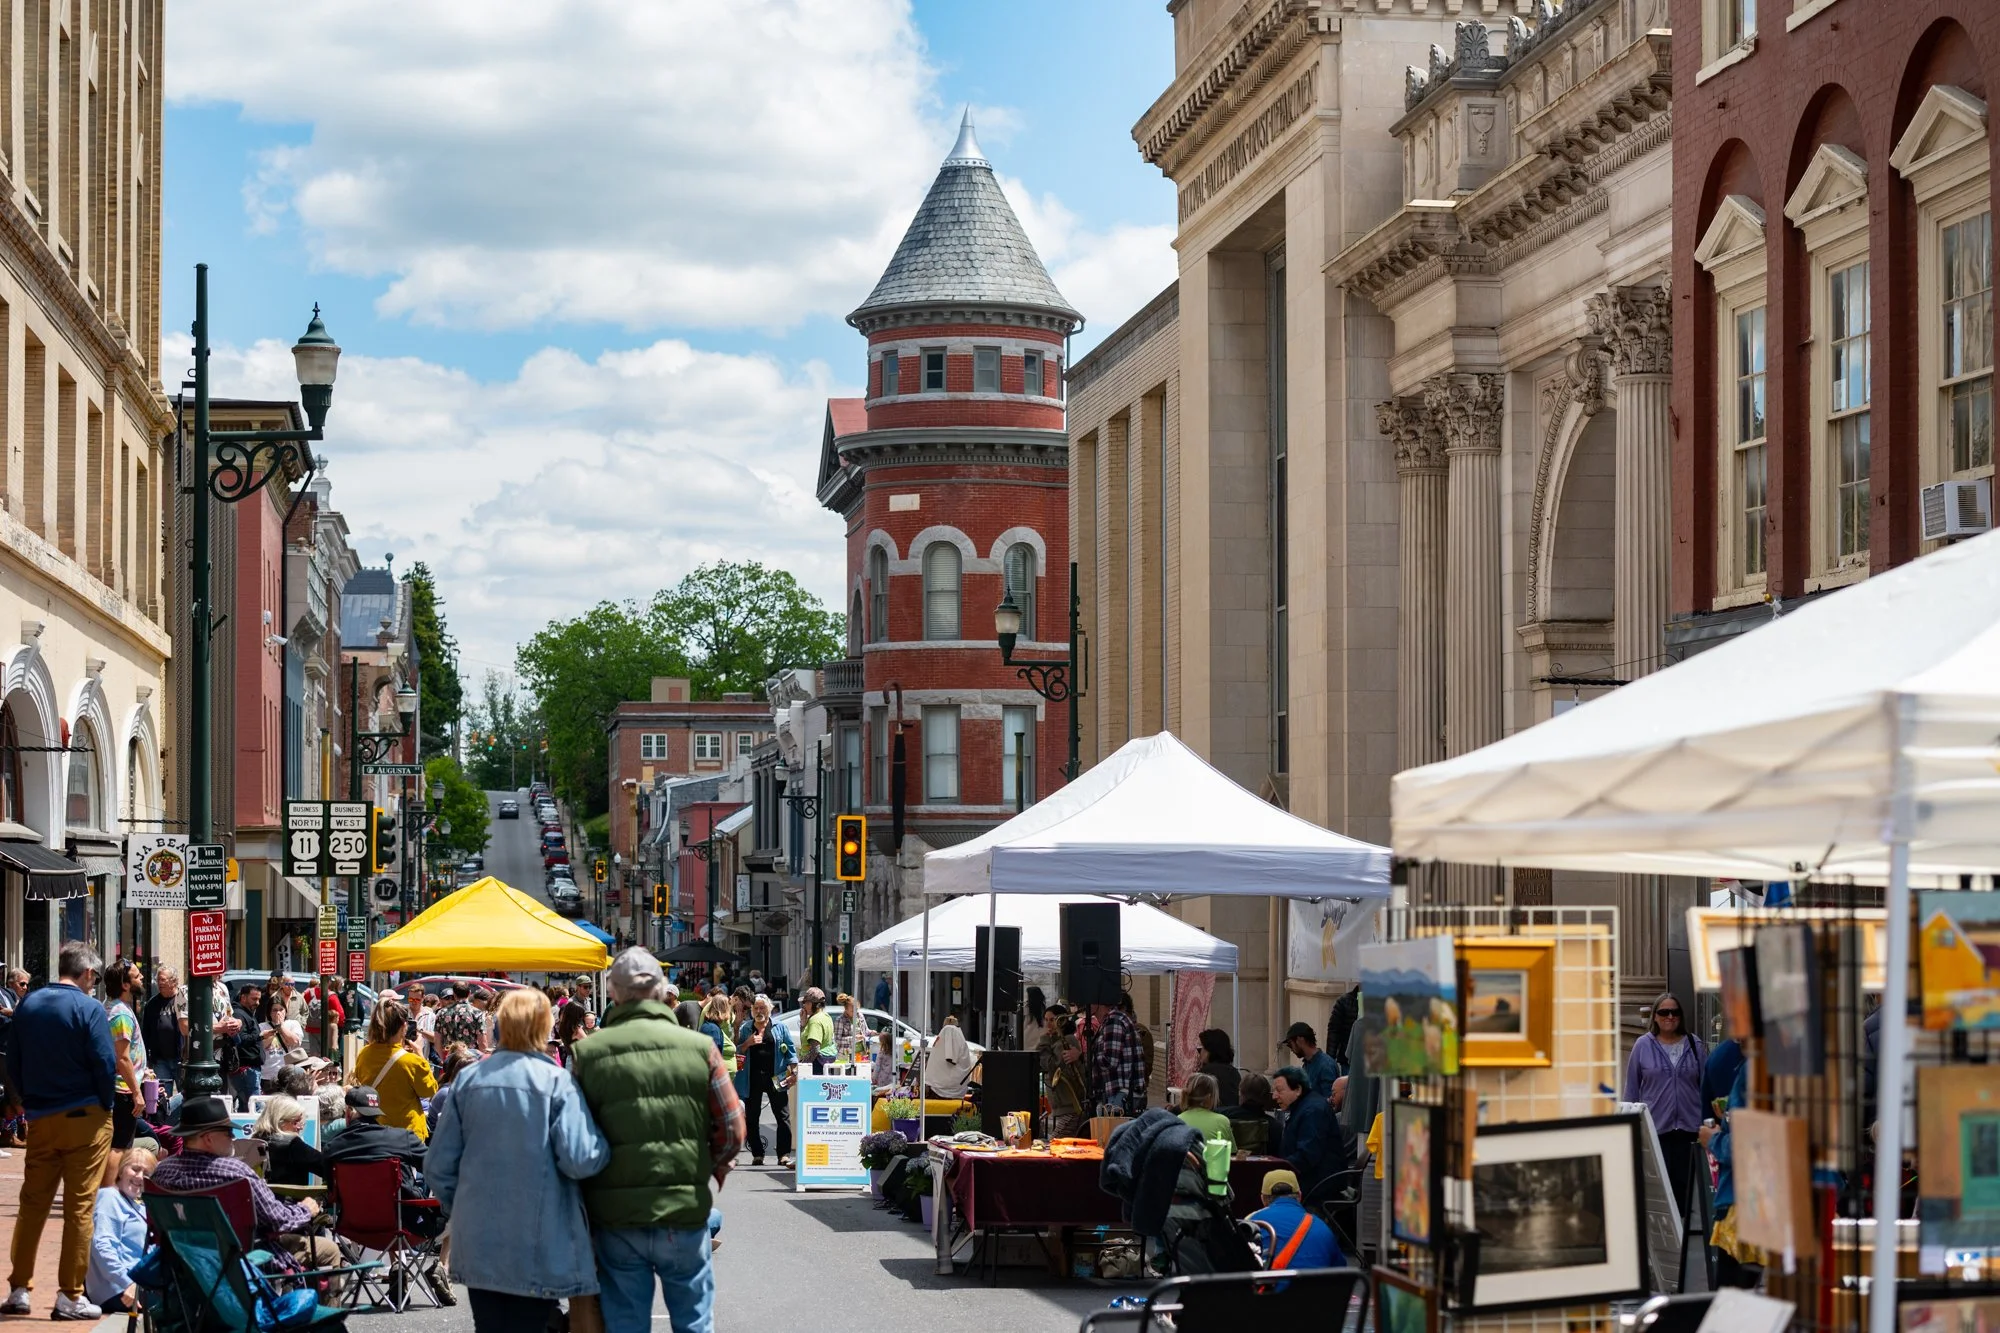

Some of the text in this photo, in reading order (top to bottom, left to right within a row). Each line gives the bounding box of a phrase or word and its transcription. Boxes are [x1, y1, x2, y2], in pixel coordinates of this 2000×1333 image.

[300, 838, 311, 853] 11
[332, 837, 364, 853] 250
[133, 838, 186, 883] BAJA BEA
[189, 850, 197, 865] 2
[379, 883, 393, 896] 17
[131, 890, 185, 899] RESTAURAN
[139, 898, 145, 906] Y
[202, 916, 213, 924] NO
[194, 925, 221, 933] PARKING
[195, 933, 220, 942] FRIDAY
[197, 943, 219, 951] AFTER
[196, 951, 221, 960] 4:00PM
[278, 944, 289, 972] OPE
